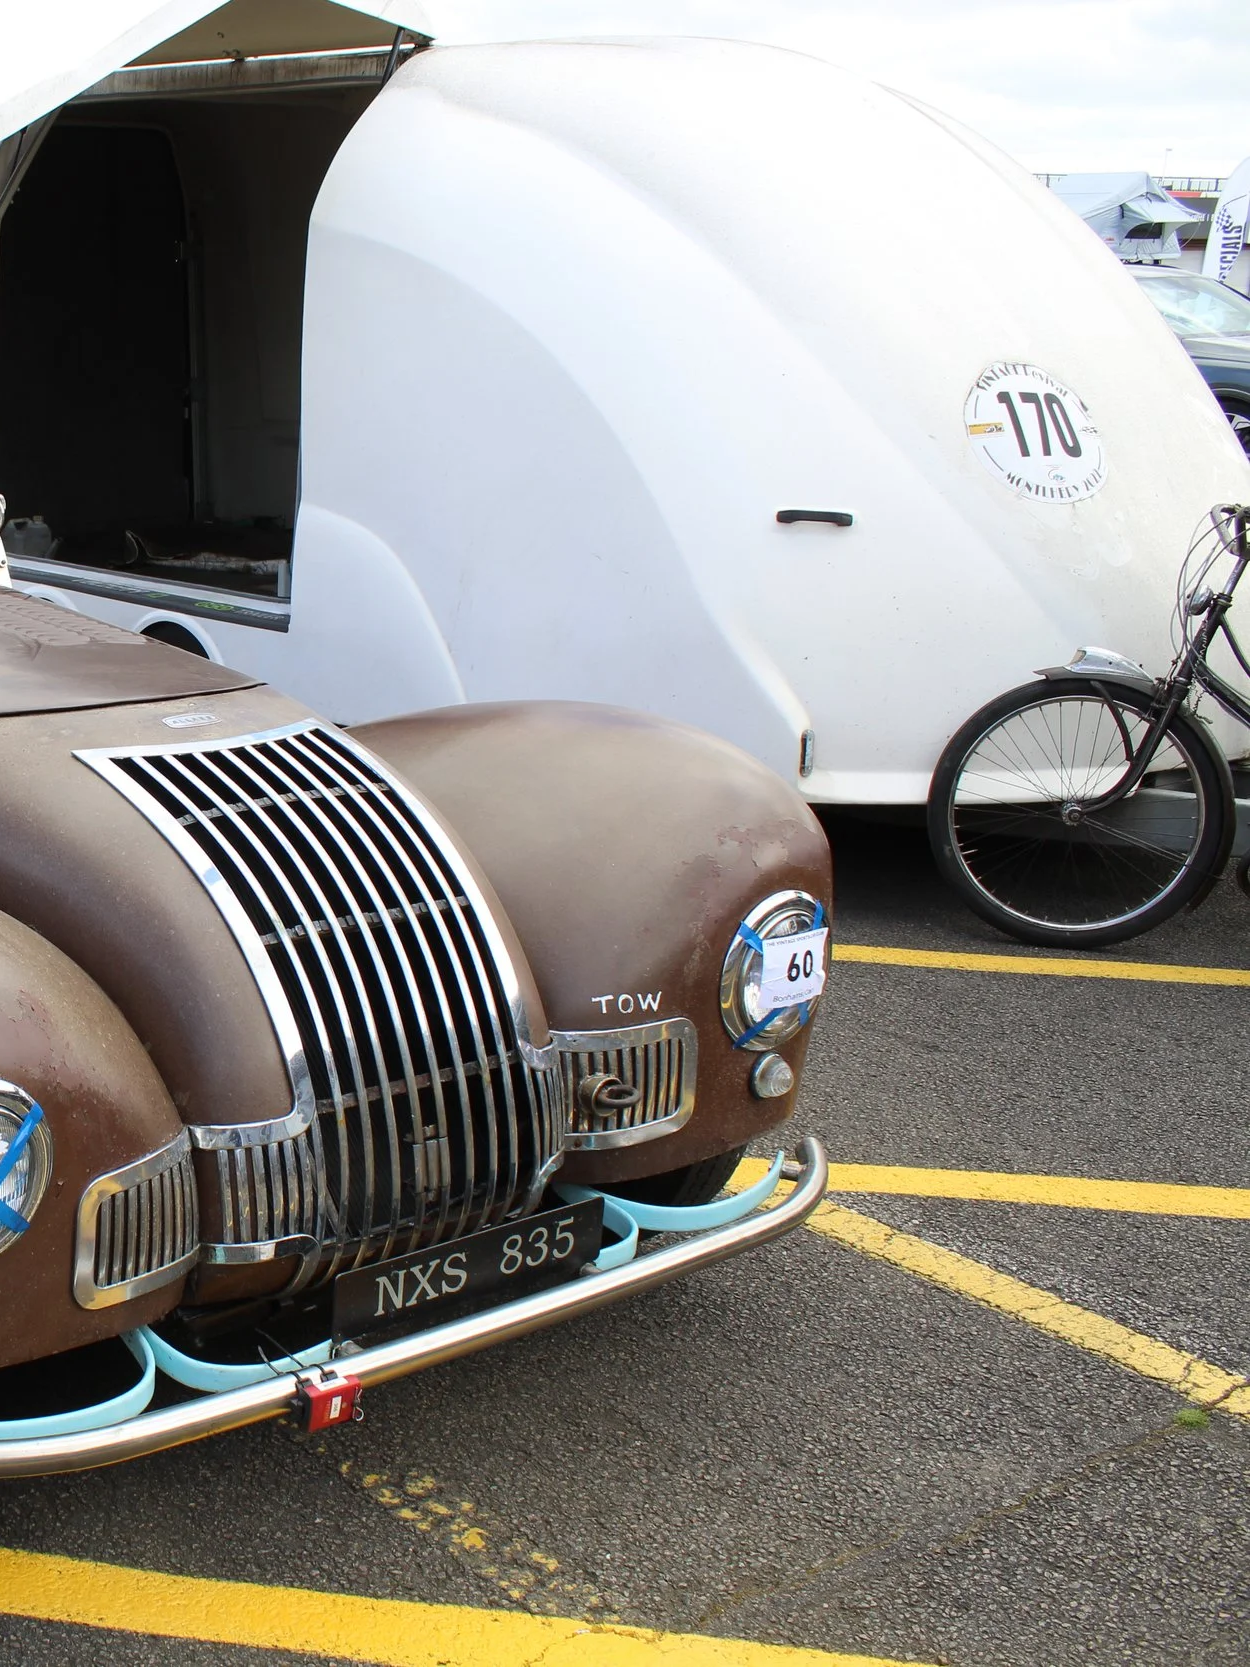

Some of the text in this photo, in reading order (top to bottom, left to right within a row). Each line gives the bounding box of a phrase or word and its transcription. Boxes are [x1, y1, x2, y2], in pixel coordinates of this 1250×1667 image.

[996, 391, 1082, 458] 170
[787, 949, 814, 982] 60
[591, 990, 662, 1014] TOW
[374, 1216, 576, 1317] NXS 835
